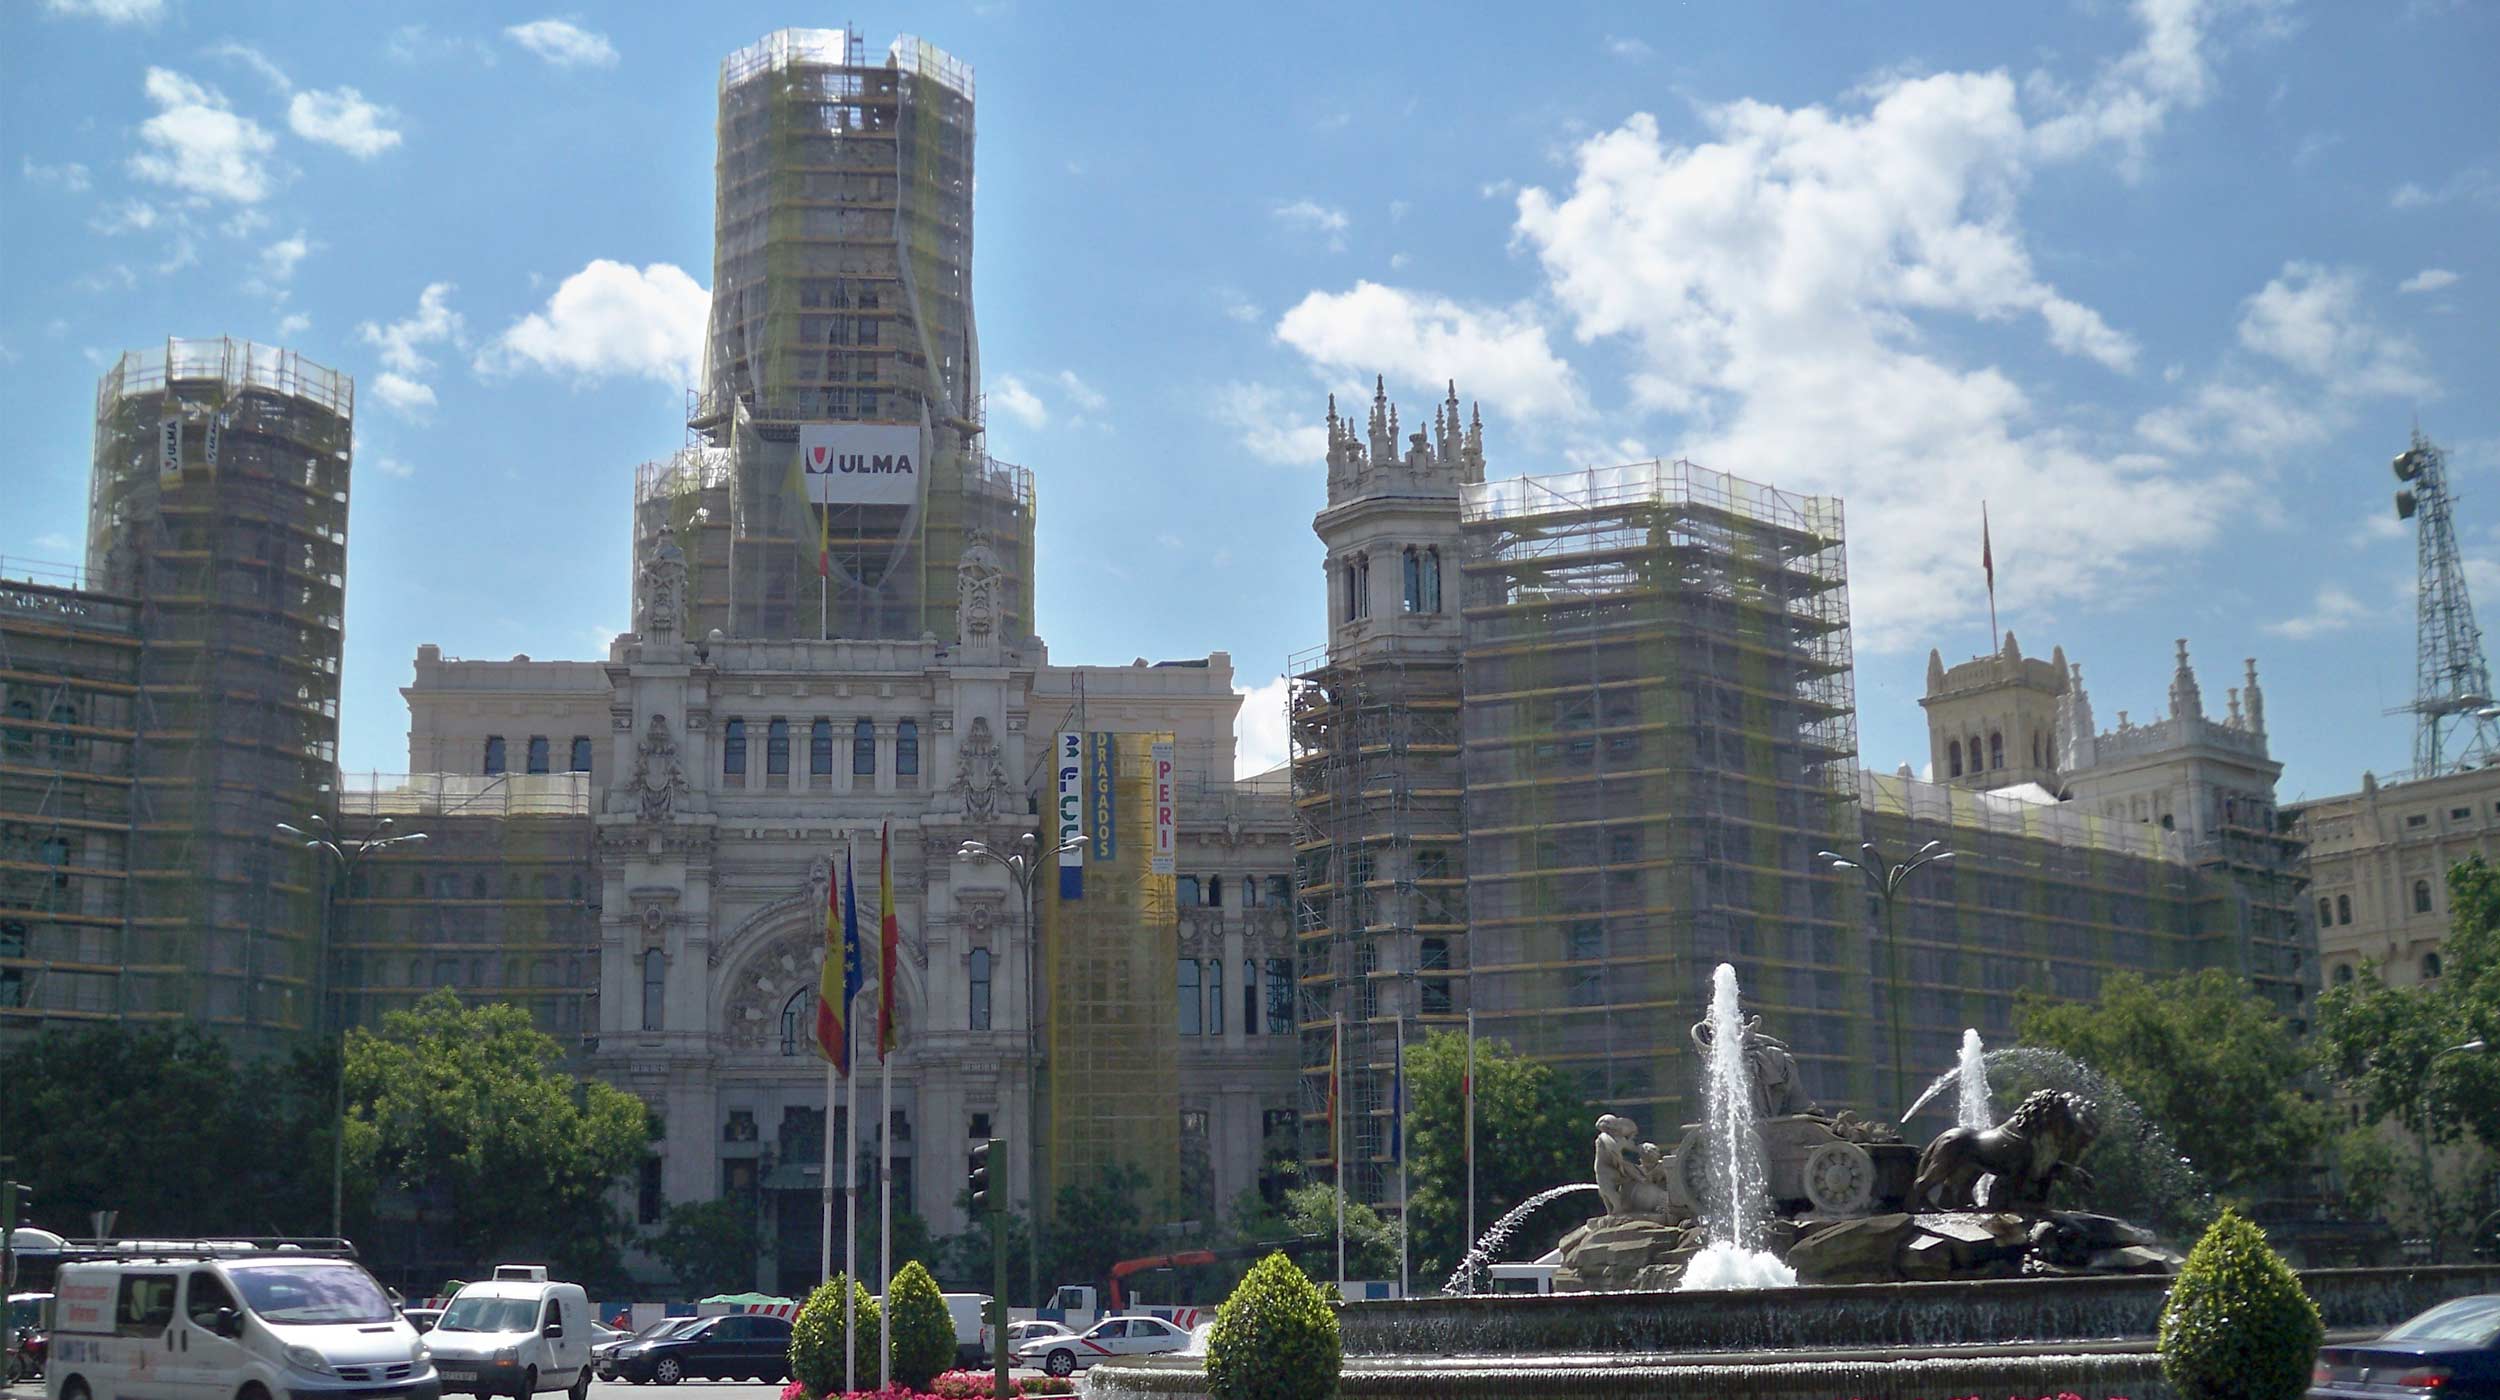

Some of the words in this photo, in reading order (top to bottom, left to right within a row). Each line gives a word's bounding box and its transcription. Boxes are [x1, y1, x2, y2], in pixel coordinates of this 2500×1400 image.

[166, 421, 177, 455] ULMA
[839, 455, 913, 473] ULMA
[1096, 733, 1109, 856] DRAGADOS
[1159, 760, 1172, 848] PERI
